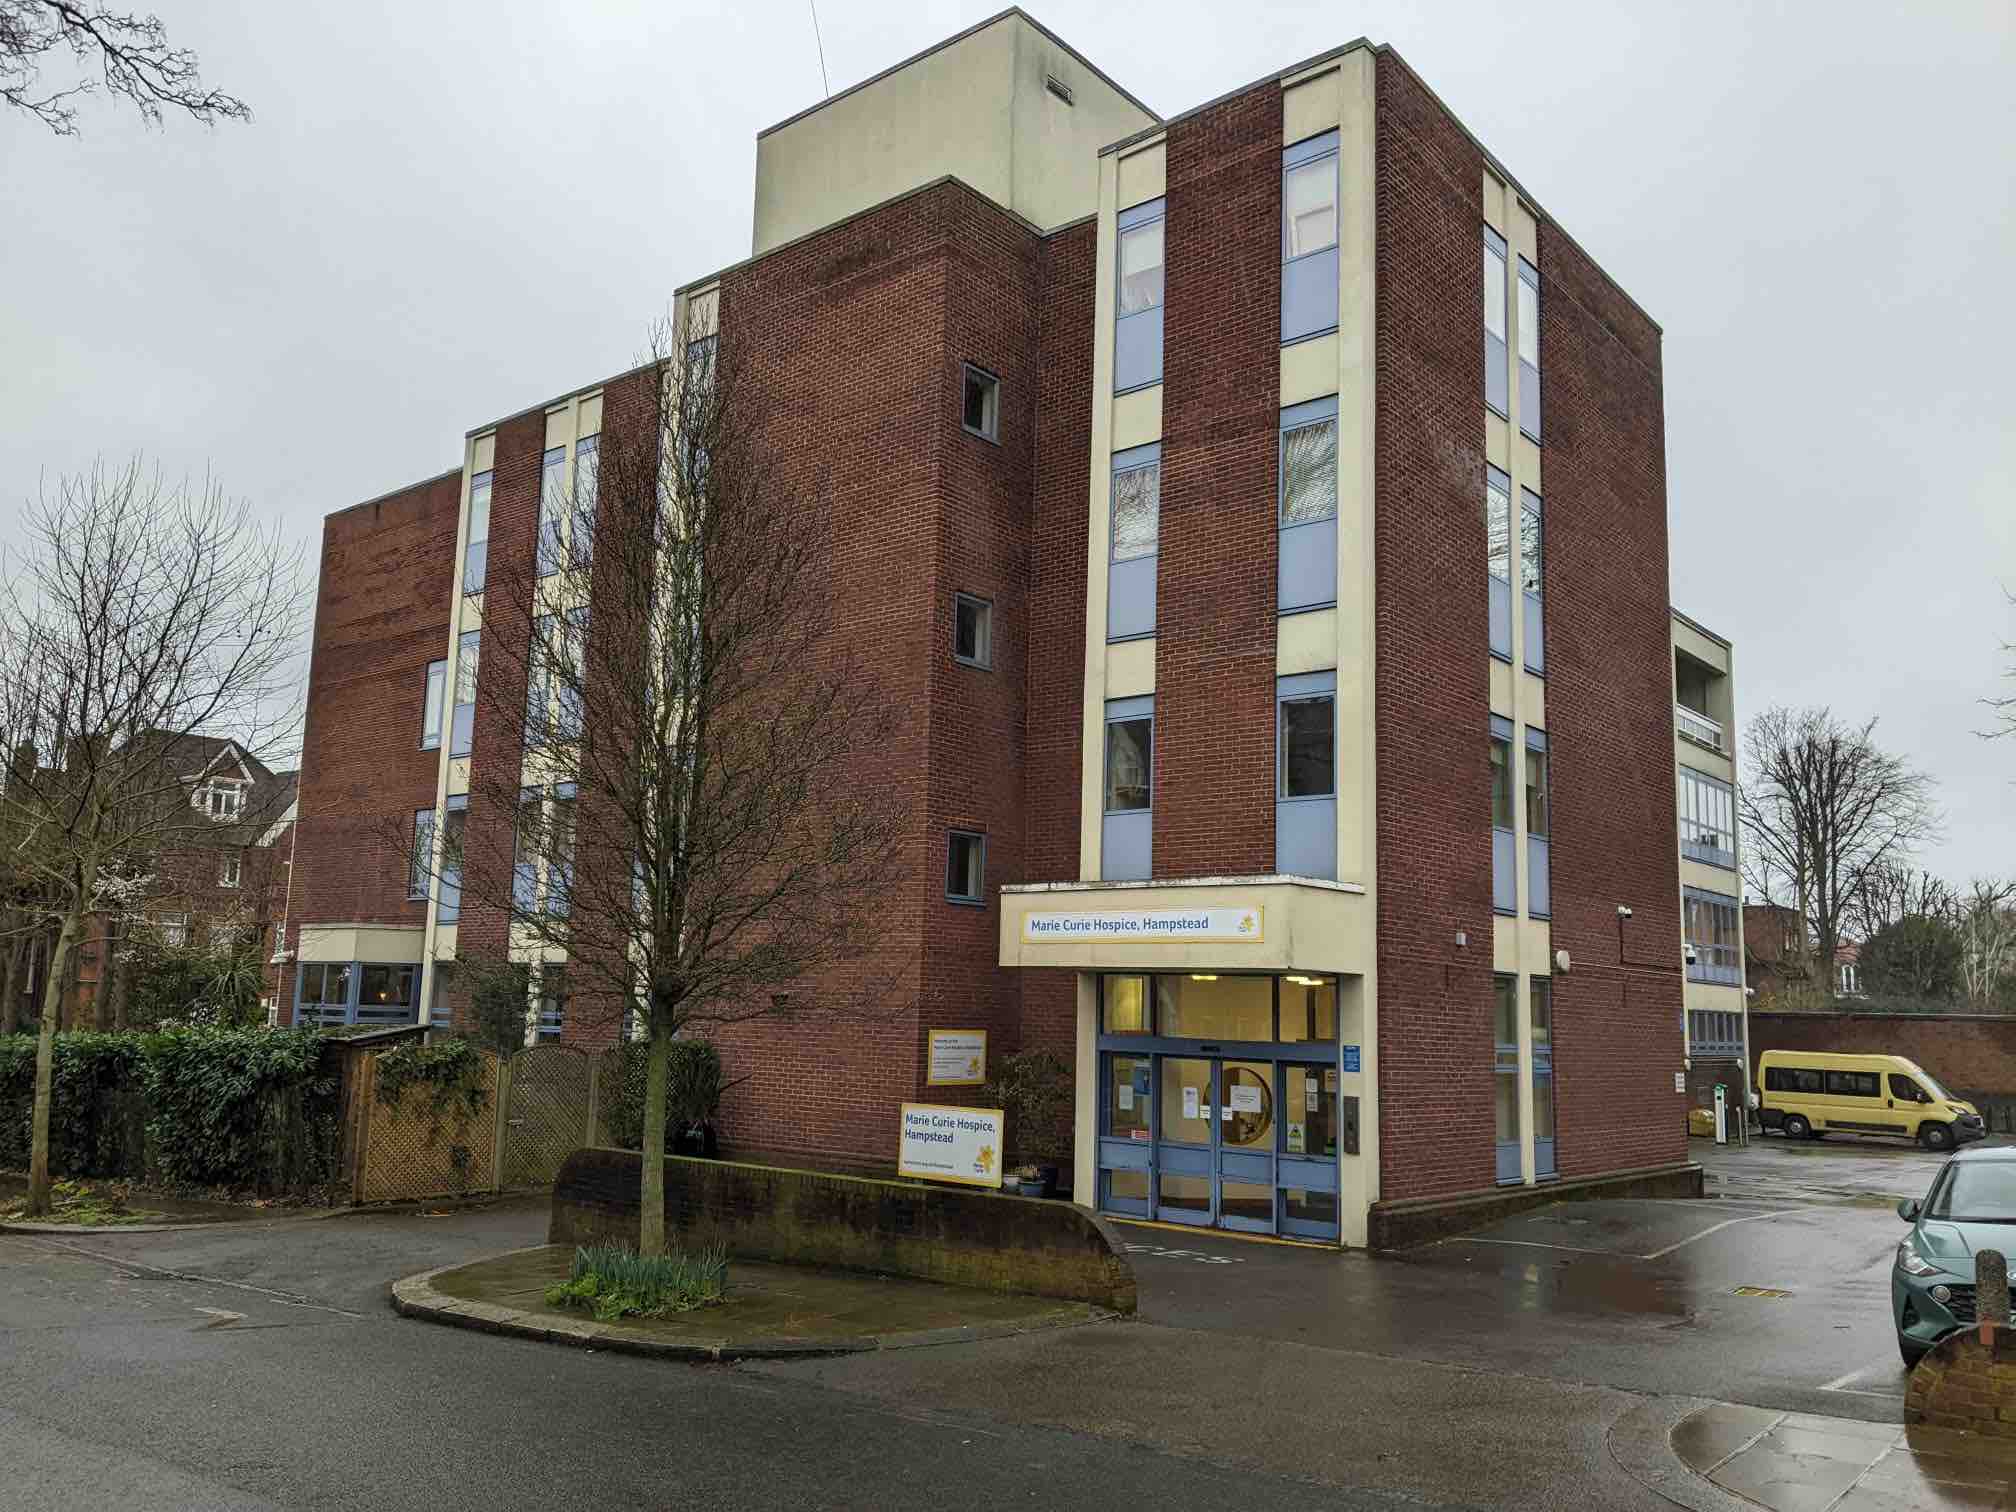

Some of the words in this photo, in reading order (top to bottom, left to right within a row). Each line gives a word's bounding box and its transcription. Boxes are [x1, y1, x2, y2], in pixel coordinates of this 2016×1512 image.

[1031, 919, 1060, 931] Marie
[1063, 919, 1091, 931] Curie
[1094, 918, 1140, 933] Hospice,
[1143, 916, 1209, 933] Hampstead
[905, 1113, 930, 1126] Marie
[931, 1116, 956, 1128] Curie
[957, 1118, 995, 1134] Hospice,
[905, 1129, 954, 1144] Hampstead
